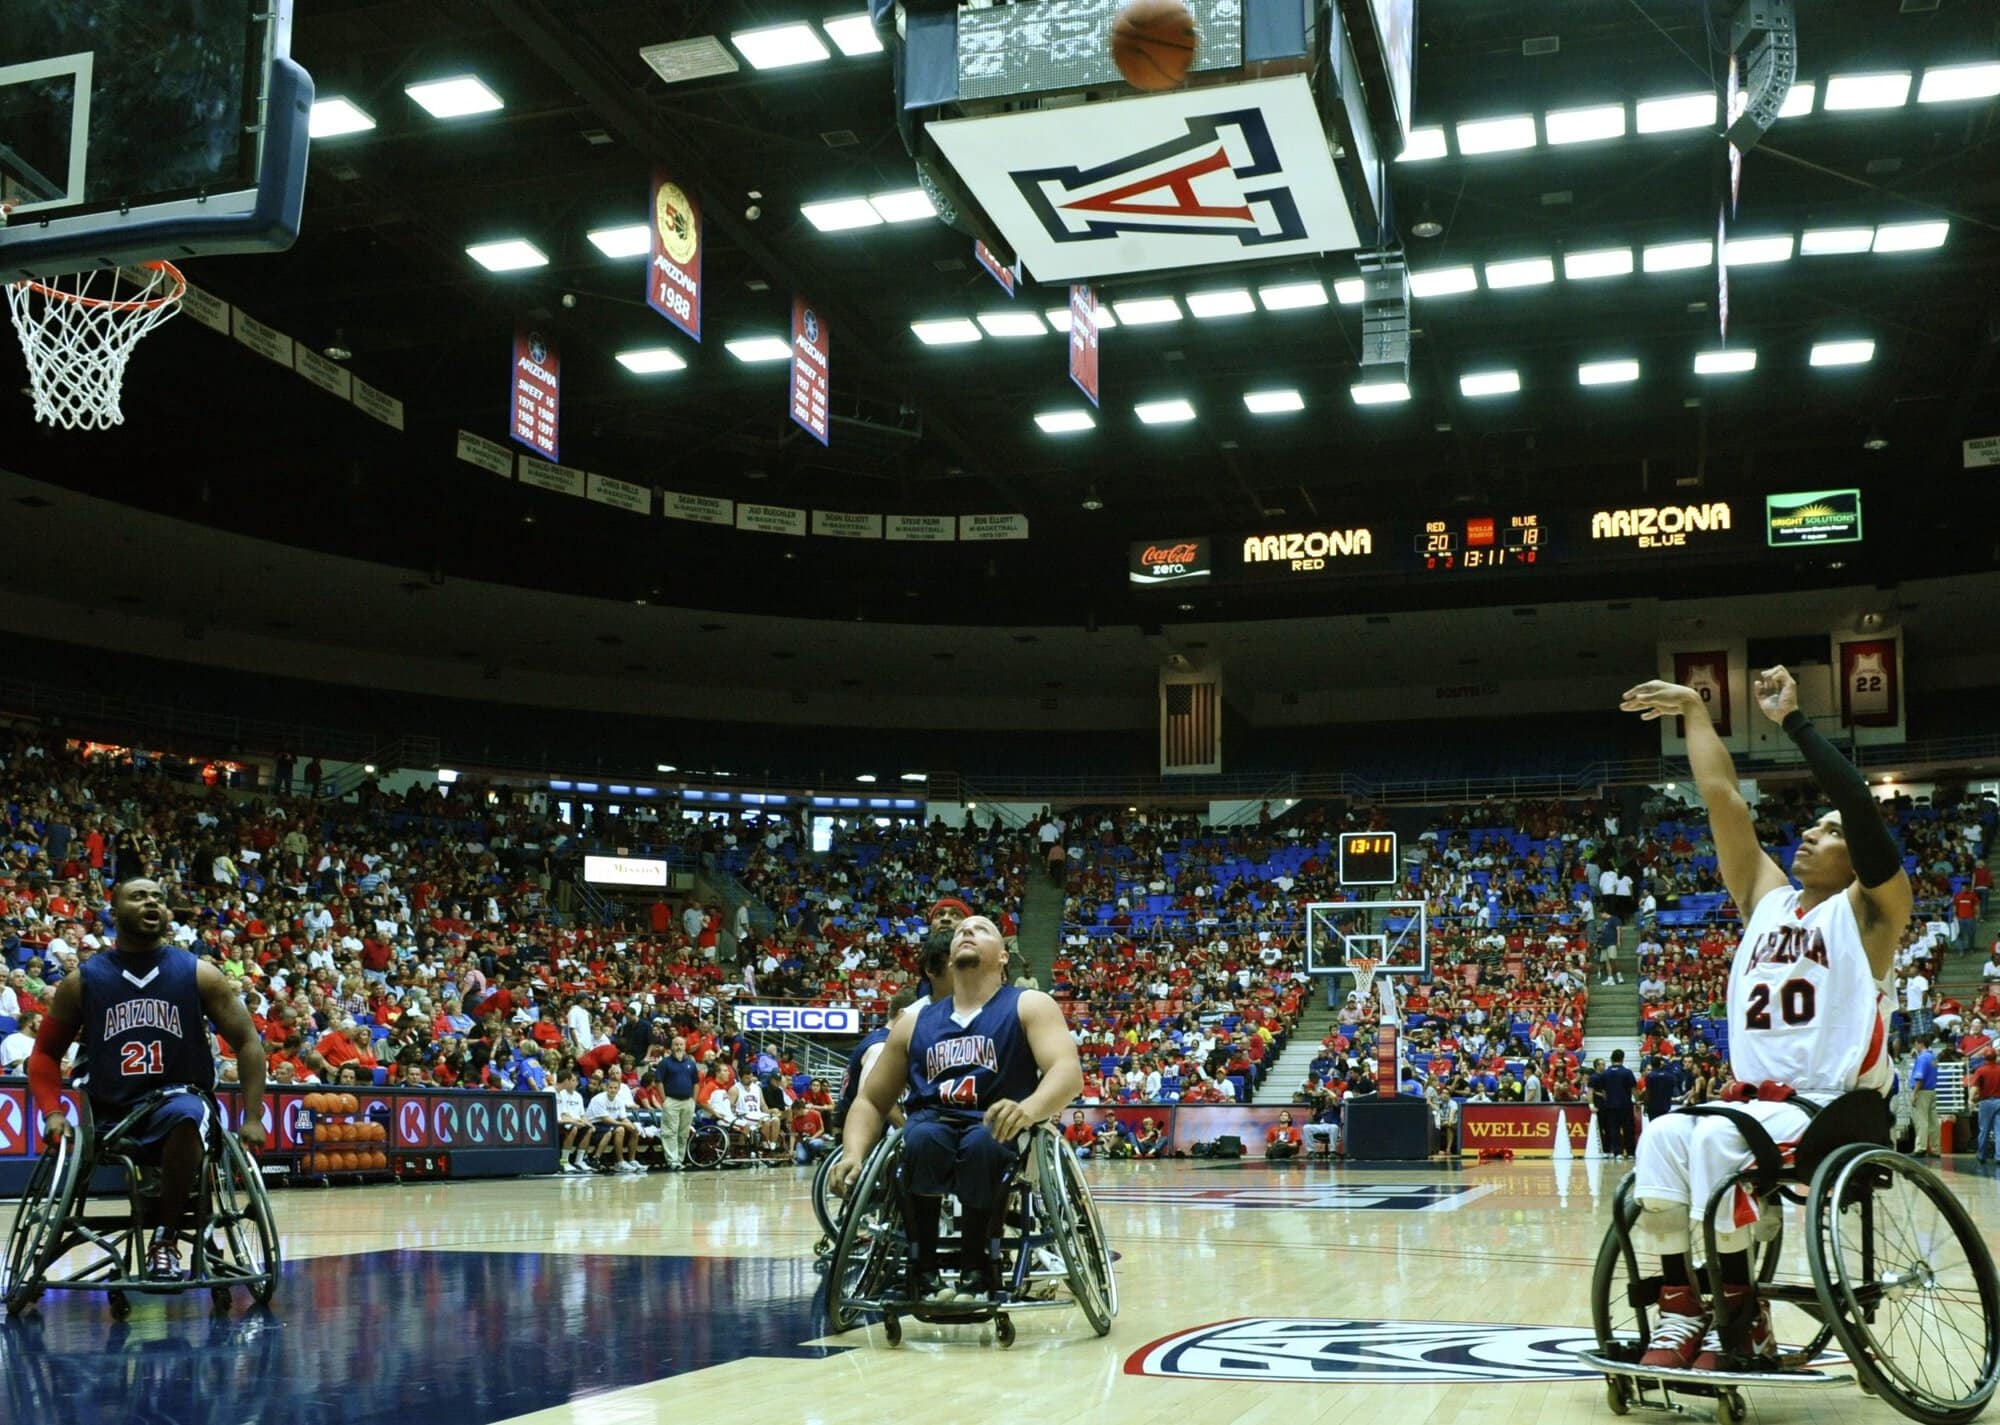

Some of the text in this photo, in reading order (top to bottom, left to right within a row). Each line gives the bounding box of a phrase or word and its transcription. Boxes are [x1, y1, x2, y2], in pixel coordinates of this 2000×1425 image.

[1007, 106, 1309, 247] A
[654, 255, 697, 297] ARIZONA
[660, 283, 691, 320] 1988
[796, 334, 826, 369] ARIZONA
[518, 356, 556, 388] ARIZONA
[796, 357, 817, 380] SWEET
[518, 379, 555, 408] SWEET 16
[1426, 522, 1446, 533] RED
[1511, 515, 1537, 527] BLUE
[1592, 502, 1731, 539] ARIZONA
[1771, 513, 1855, 528] BRIGHT SOLUTIONS
[1244, 528, 1371, 562] ARIZONA
[1428, 535, 1449, 551] 20
[1523, 528, 1538, 544] 18
[1638, 533, 1686, 548] BLUE
[1141, 543, 1199, 566] Coca-Cola
[1291, 559, 1325, 571] RED
[1464, 549, 1504, 567] 13:11
[1855, 676, 1881, 692] 22
[1350, 838, 1390, 853] 13:11
[1744, 925, 1830, 976] ARZOA
[1745, 978, 1815, 1031] 20
[104, 999, 183, 1041] ARIZONA
[746, 1009, 848, 1030] GEICO
[121, 1040, 164, 1076] 21
[926, 1035, 998, 1084] ARIZONA
[939, 1075, 978, 1105] 14
[1467, 1122, 1550, 1138] WELLS
